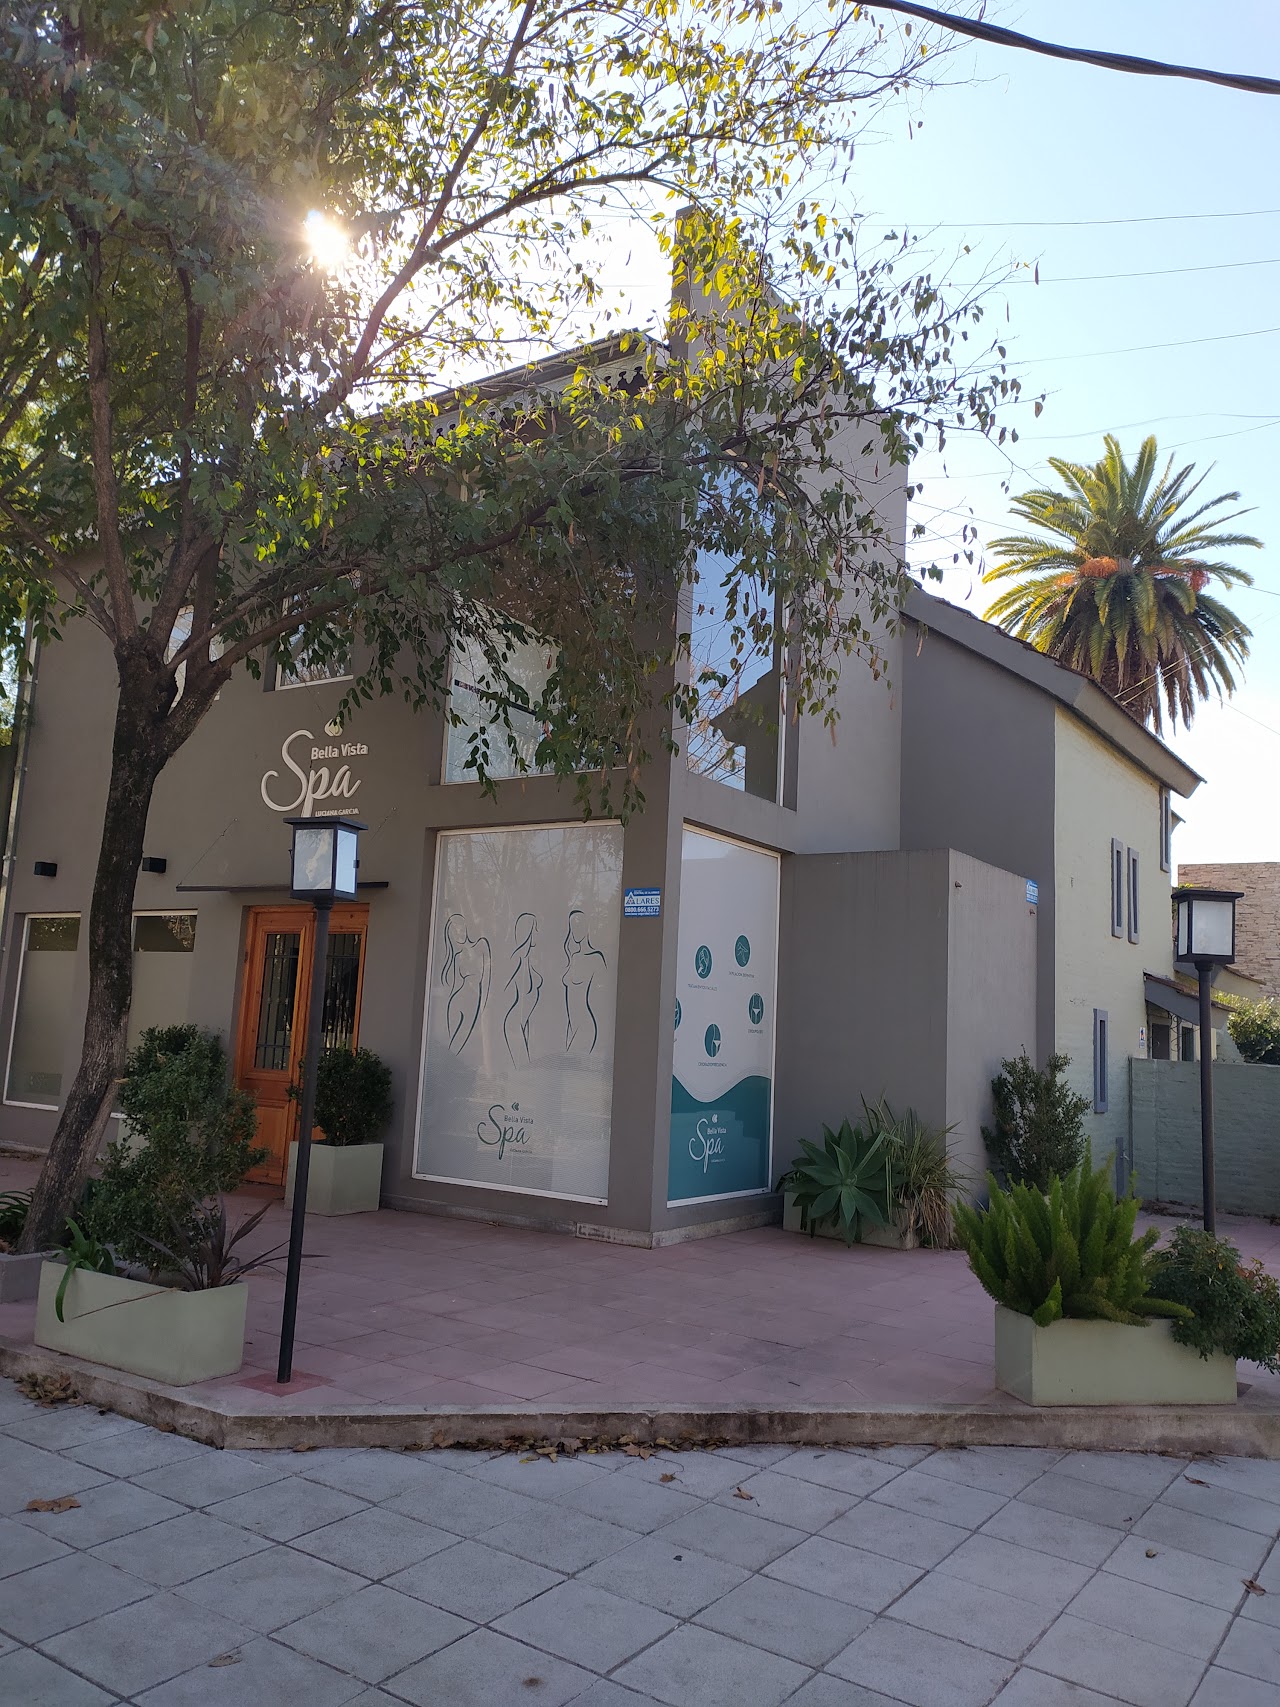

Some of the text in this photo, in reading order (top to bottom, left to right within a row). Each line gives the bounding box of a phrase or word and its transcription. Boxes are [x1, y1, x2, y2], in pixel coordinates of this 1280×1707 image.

[311, 743, 368, 760] Bella Vista
[261, 729, 362, 818] Spa
[315, 810, 338, 818] LUCIANA
[477, 1104, 531, 1160] Spa
[504, 1115, 534, 1125] Bella Vista
[688, 1118, 725, 1174] Spa
